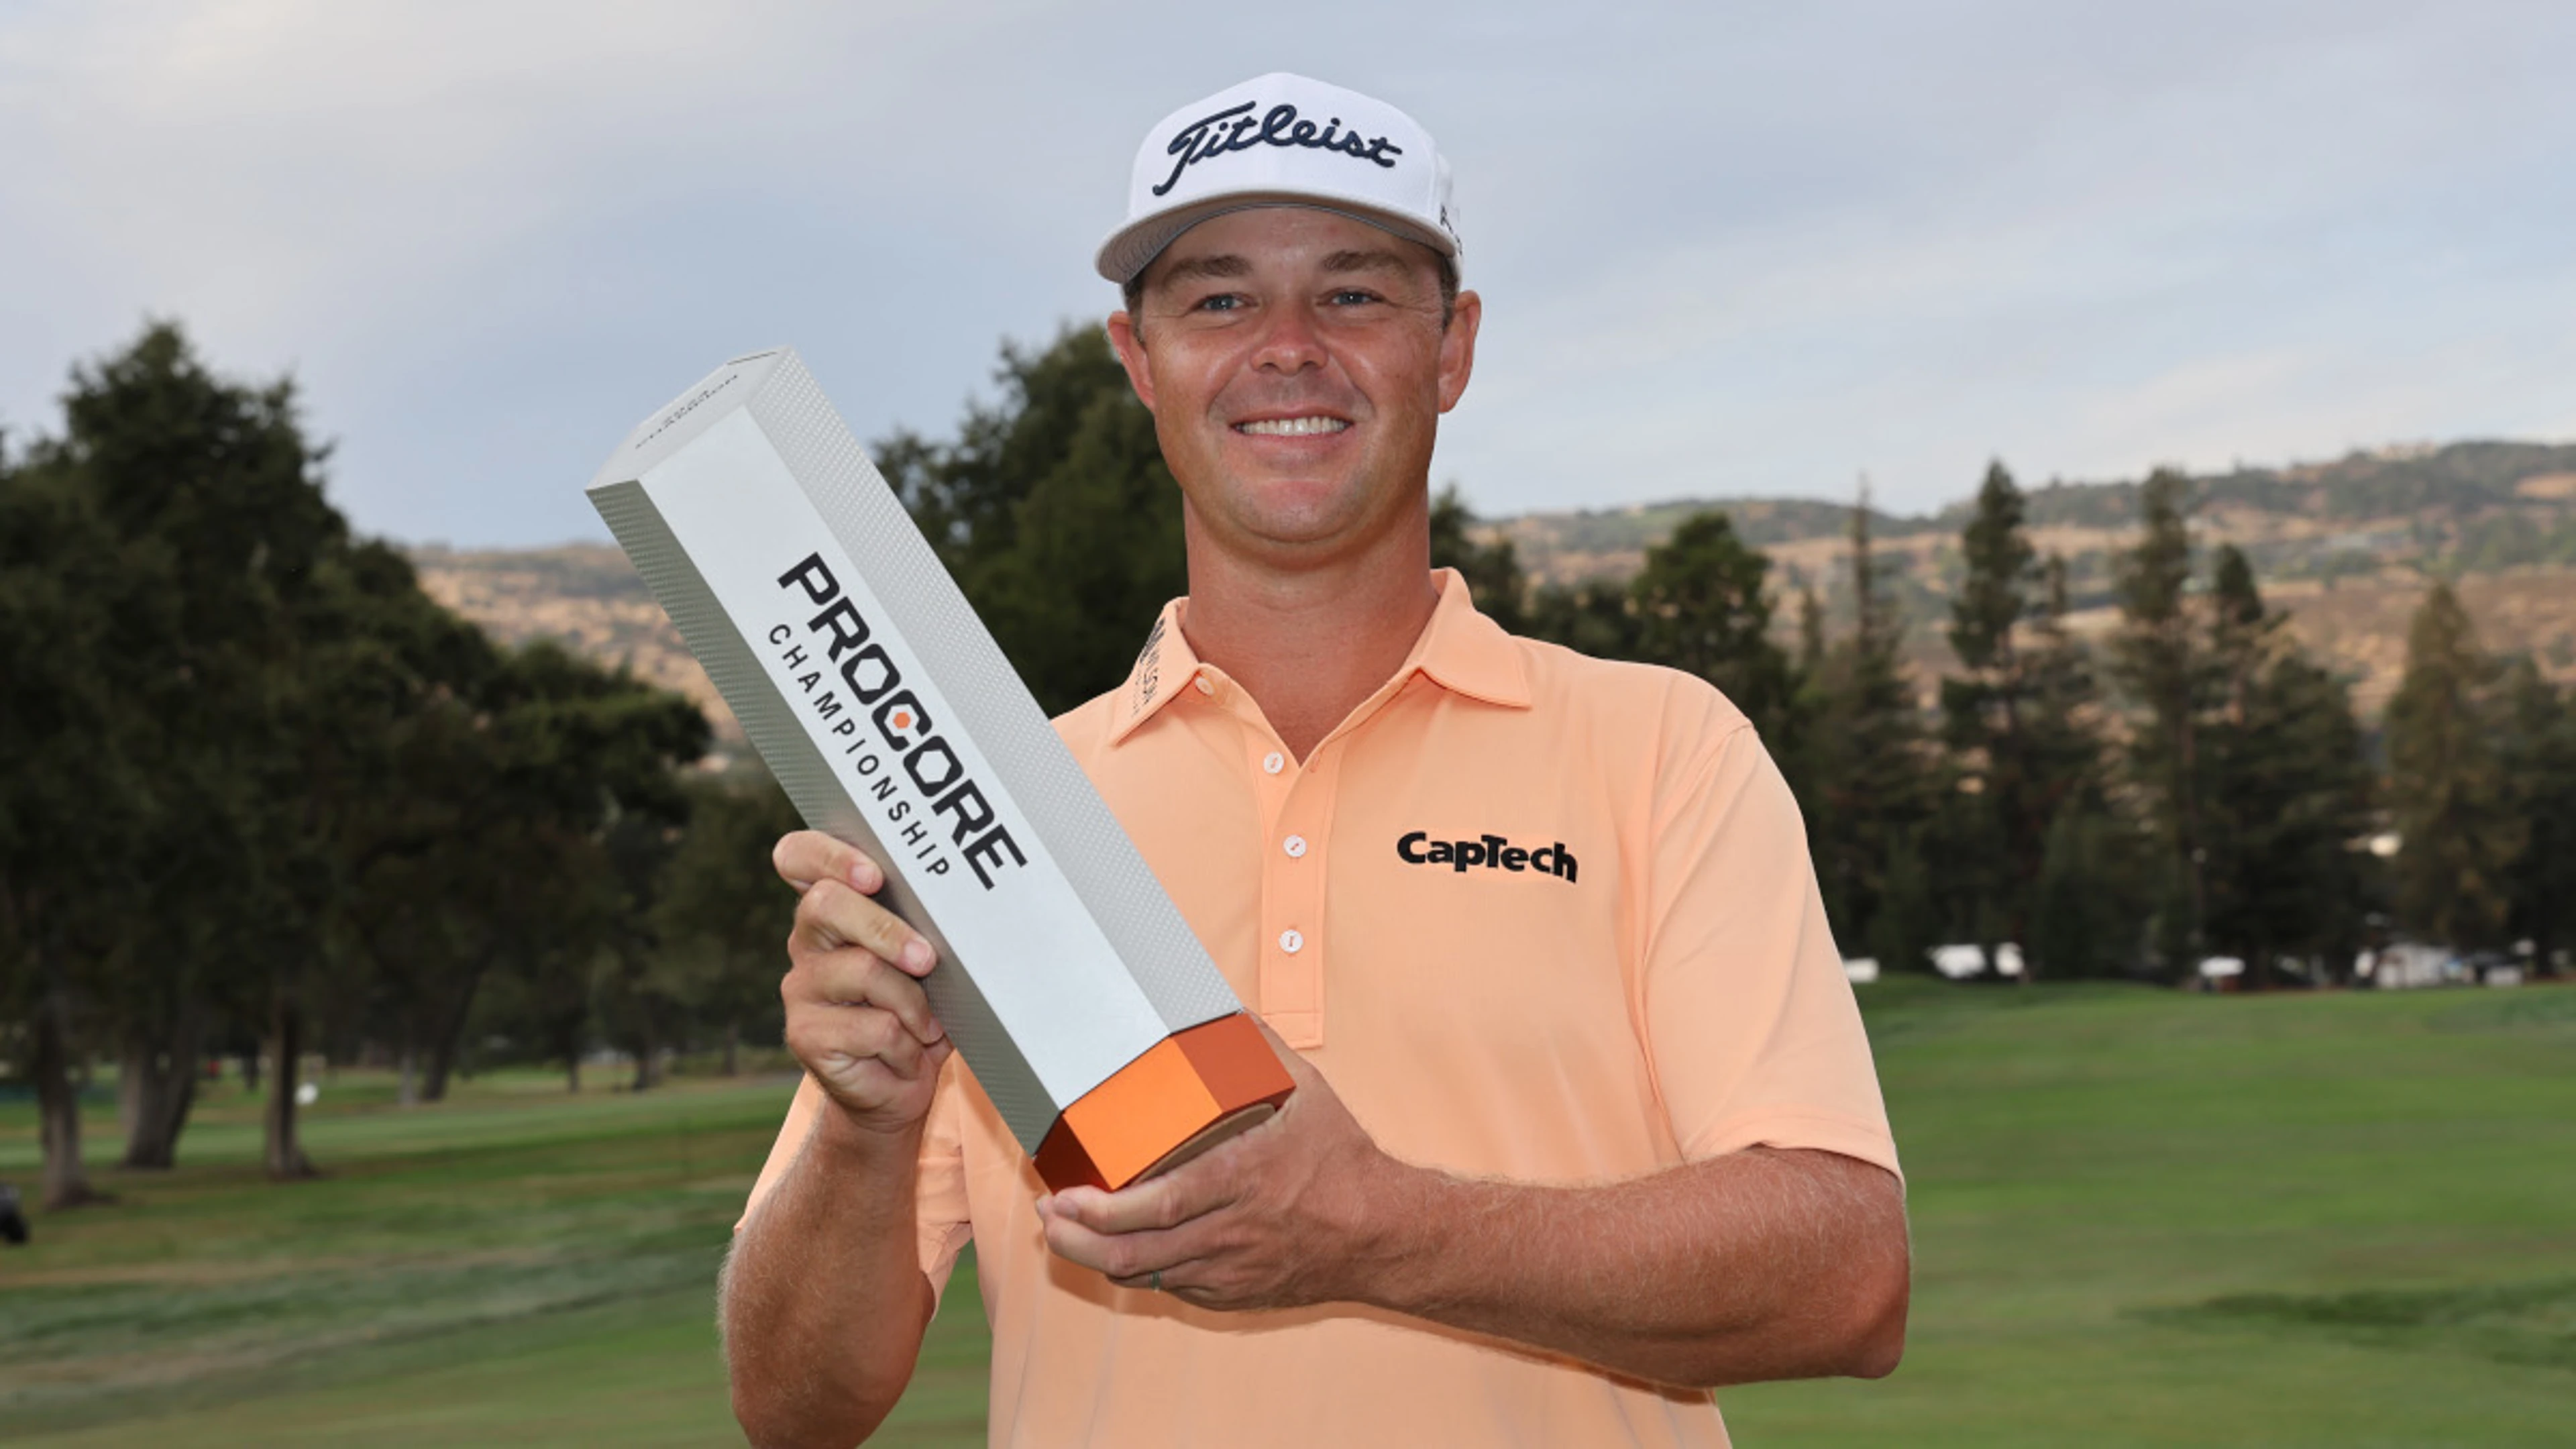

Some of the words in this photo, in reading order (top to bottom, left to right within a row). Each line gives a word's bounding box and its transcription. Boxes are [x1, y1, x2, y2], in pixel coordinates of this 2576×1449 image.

[1151, 100, 1403, 197] Titleist
[769, 623, 950, 877] CHAMPIONSHIP
[777, 551, 1028, 892] PROCORE
[1396, 831, 1578, 884] CapTech
